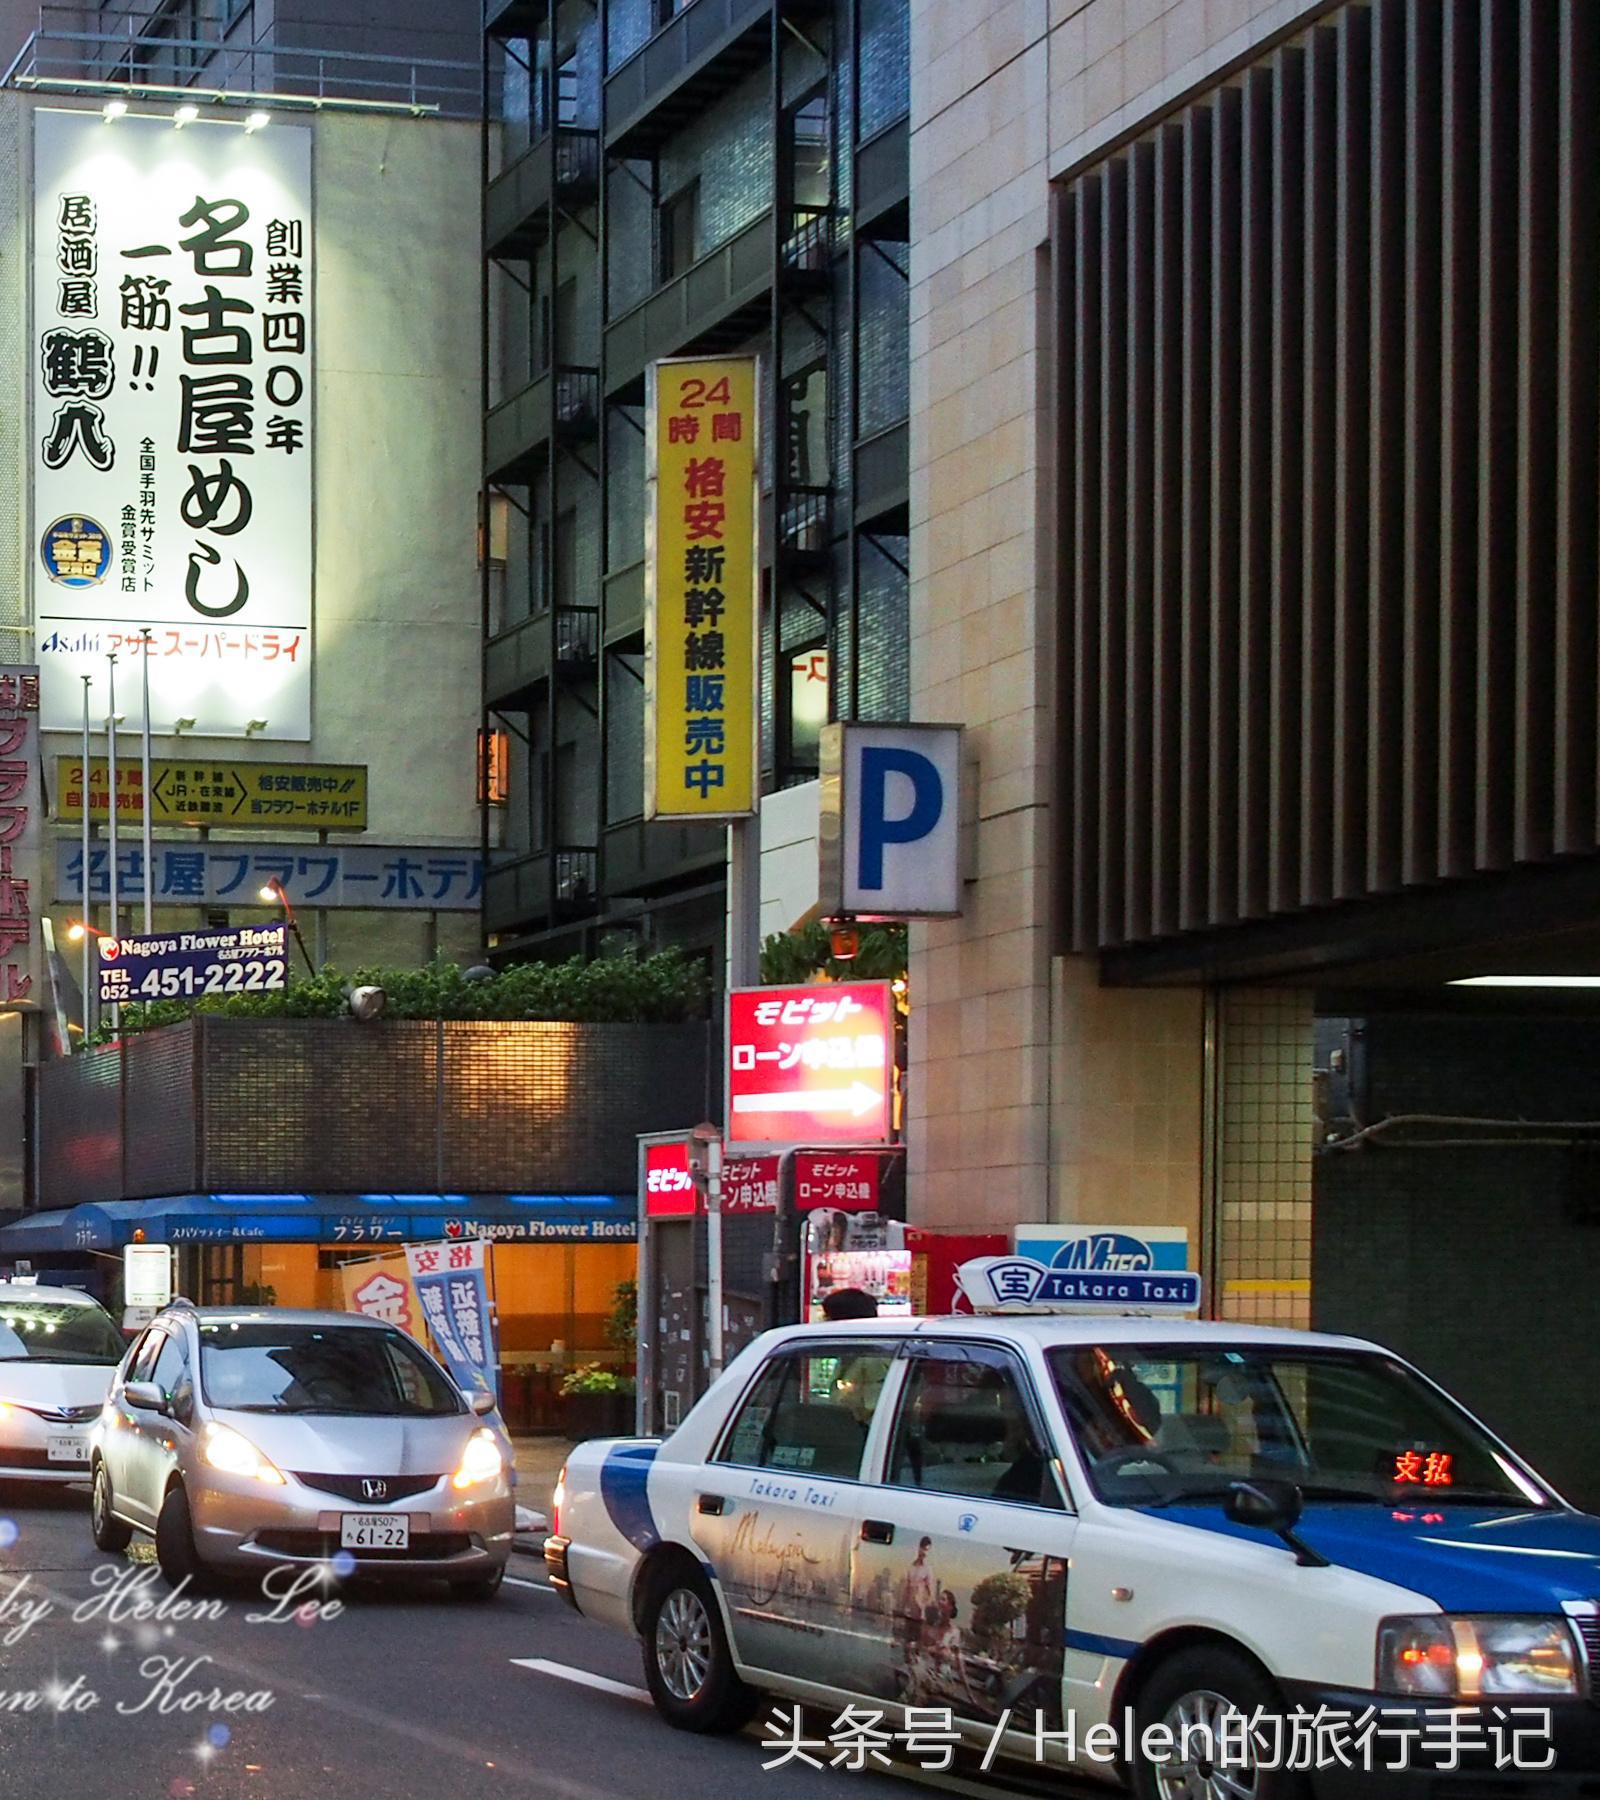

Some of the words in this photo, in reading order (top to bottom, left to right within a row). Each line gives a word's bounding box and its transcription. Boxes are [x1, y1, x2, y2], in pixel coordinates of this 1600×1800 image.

[57, 193, 98, 319] 居酒屋
[178, 195, 255, 618] 名古屋めし
[680, 377, 731, 409] 24
[668, 412, 742, 444] 時間
[139, 437, 156, 592] 全国手羽先サミット
[120, 504, 137, 593] 金賞受賞店
[683, 456, 727, 799] 格安新幹線販売中
[857, 746, 944, 891] P
[120, 938, 177, 957] Nagoya
[180, 934, 237, 951] Flower
[239, 927, 284, 946] Hotel
[100, 970, 131, 984] TEL
[753, 995, 864, 1025] モビット
[811, 1163, 860, 1177] モビット
[800, 1182, 871, 1200] ローン申込機
[333, 1225, 404, 1241] フラワー
[464, 1221, 526, 1239] Nagoya
[528, 1220, 589, 1236] Flower
[591, 1220, 638, 1236] Hotel
[1051, 1279, 1128, 1298] Takara
[1142, 1281, 1188, 1299] Taxi
[1394, 1449, 1453, 1486] 支払
[749, 1478, 798, 1502] Takara
[803, 1486, 837, 1507] Taxi
[356, 1528, 405, 1546] 61-22
